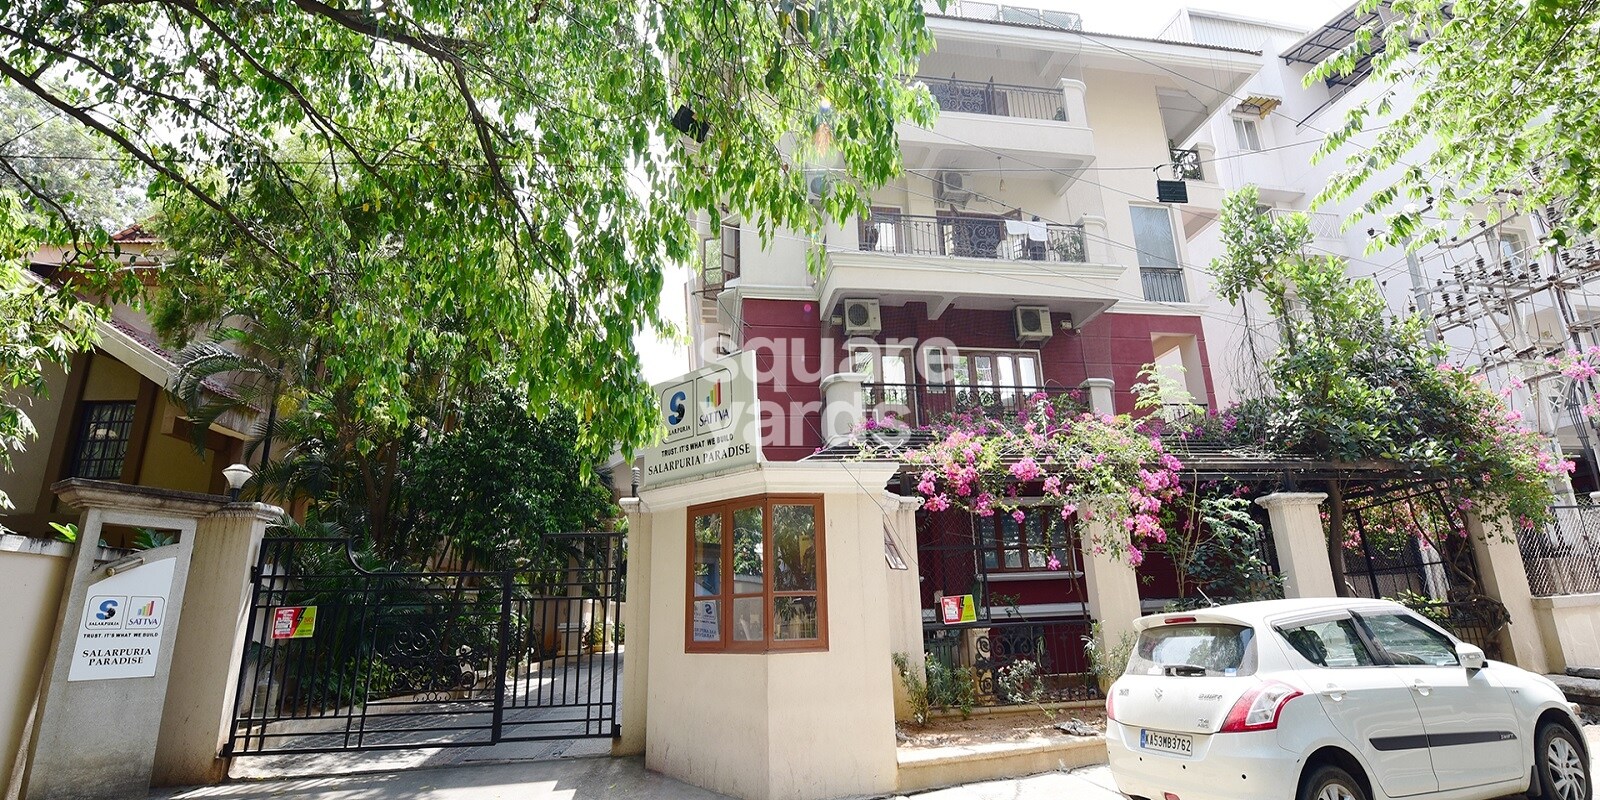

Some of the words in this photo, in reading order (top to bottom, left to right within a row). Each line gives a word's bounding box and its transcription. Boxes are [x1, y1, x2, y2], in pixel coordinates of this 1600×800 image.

[698, 408, 730, 427] SATTVA
[661, 447, 679, 458] TRUST.
[679, 443, 689, 453] IT'S
[690, 440, 705, 450] WHAT
[707, 437, 716, 446] WE
[717, 433, 734, 444] BUILD
[648, 455, 701, 475] SALARPURIA
[703, 443, 751, 463] PARADISE
[128, 618, 158, 626] SATTVA
[82, 648, 152, 658] SALARPURIA
[88, 656, 144, 666] PARADISE
[1145, 733, 1191, 752] KA53MB3762
